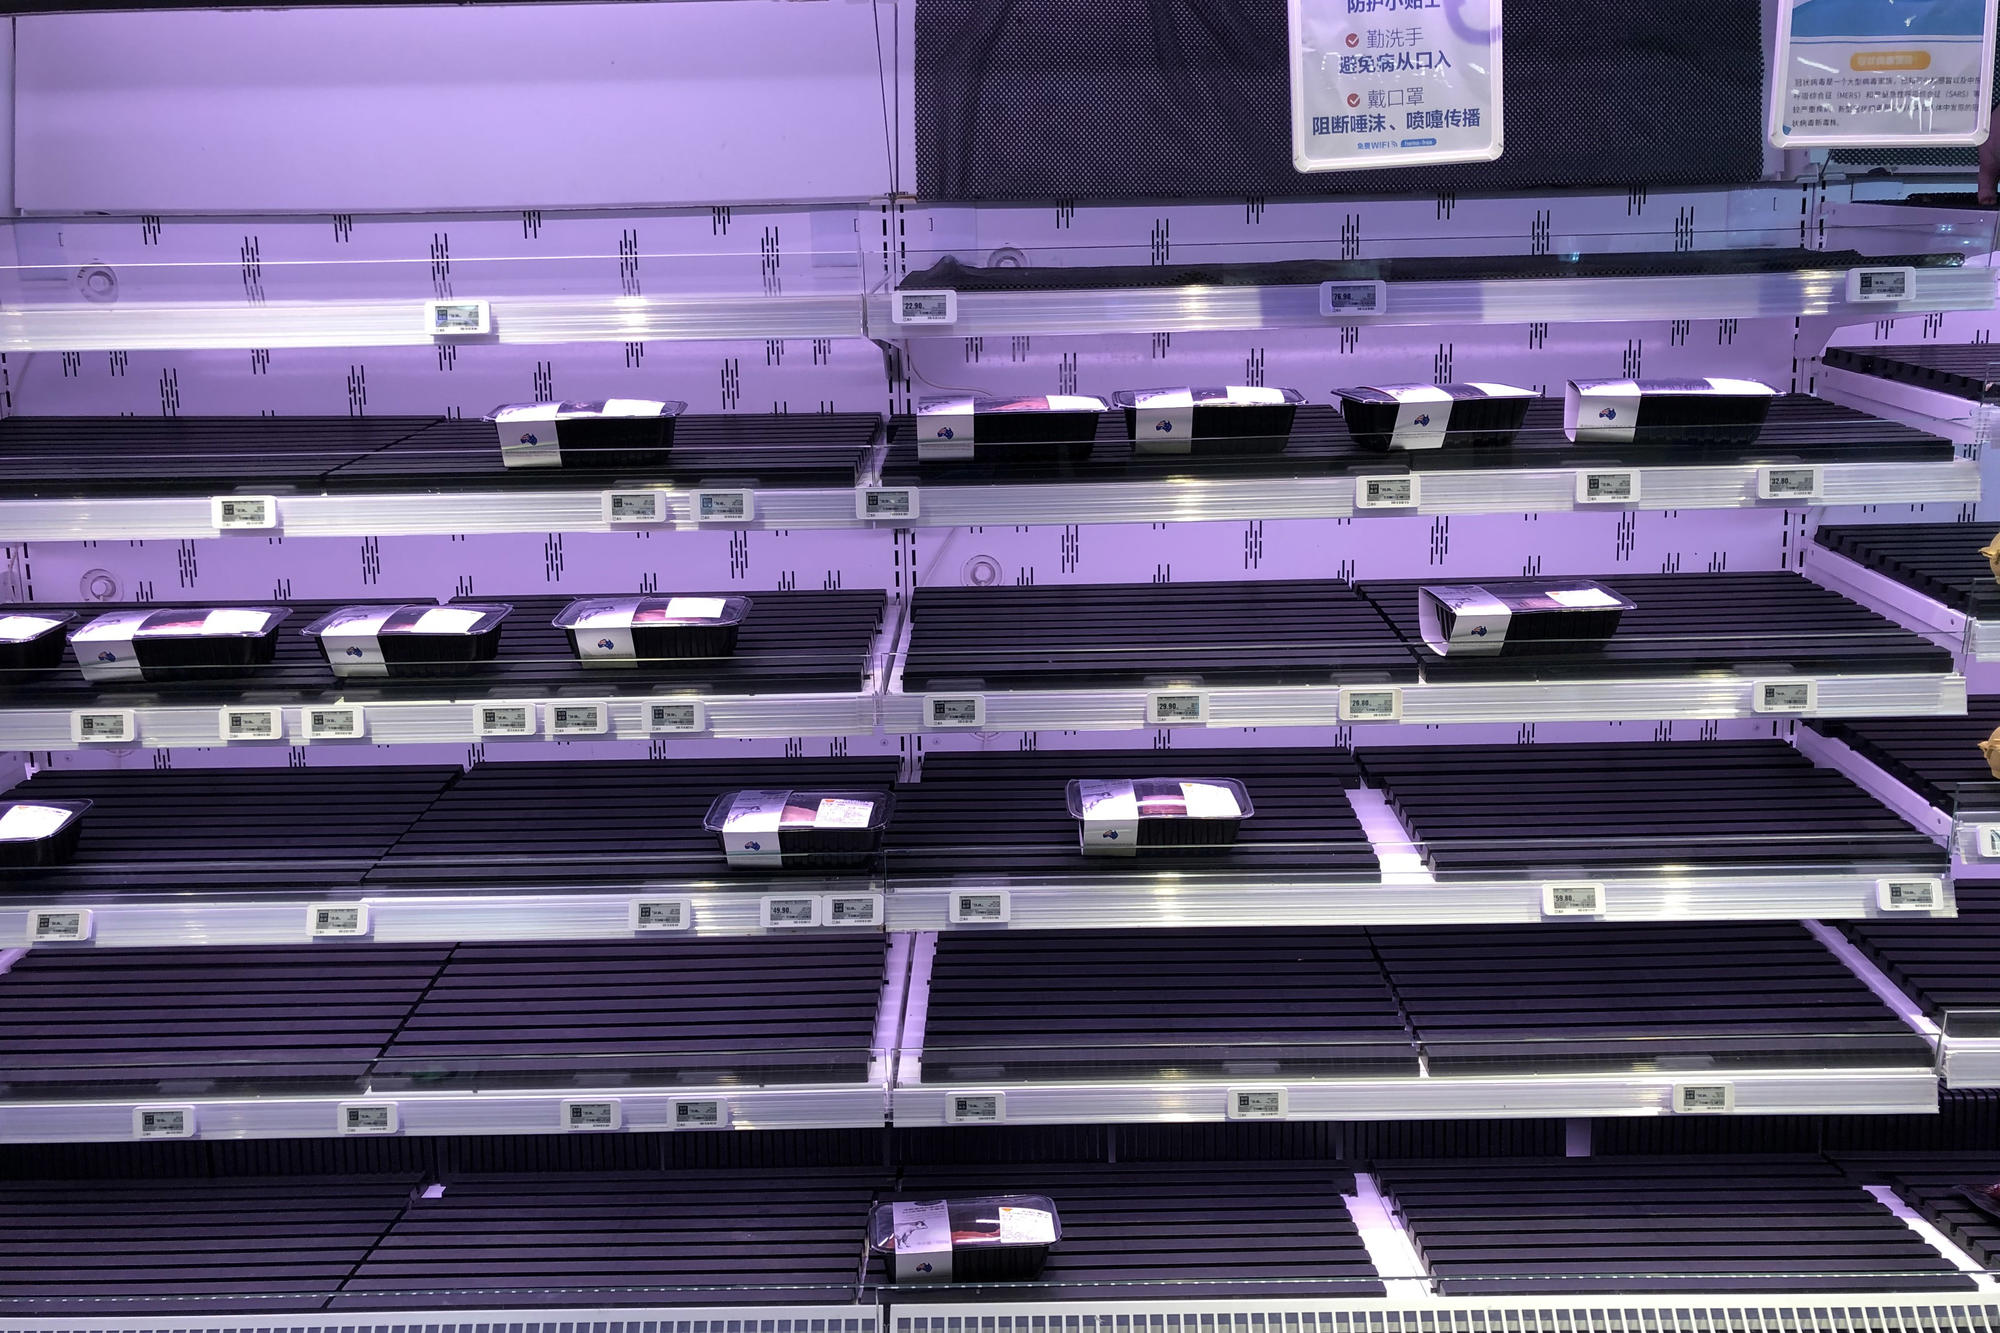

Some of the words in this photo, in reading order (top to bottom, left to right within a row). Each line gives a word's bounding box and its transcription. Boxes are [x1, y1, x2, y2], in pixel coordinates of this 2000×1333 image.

[1366, 27, 1424, 49] 勤洗手
[1339, 50, 1451, 74] 避免病从口入
[1367, 87, 1425, 109] 戴口罩
[1312, 108, 1480, 136] 阻断唾沫、喷嚏传播
